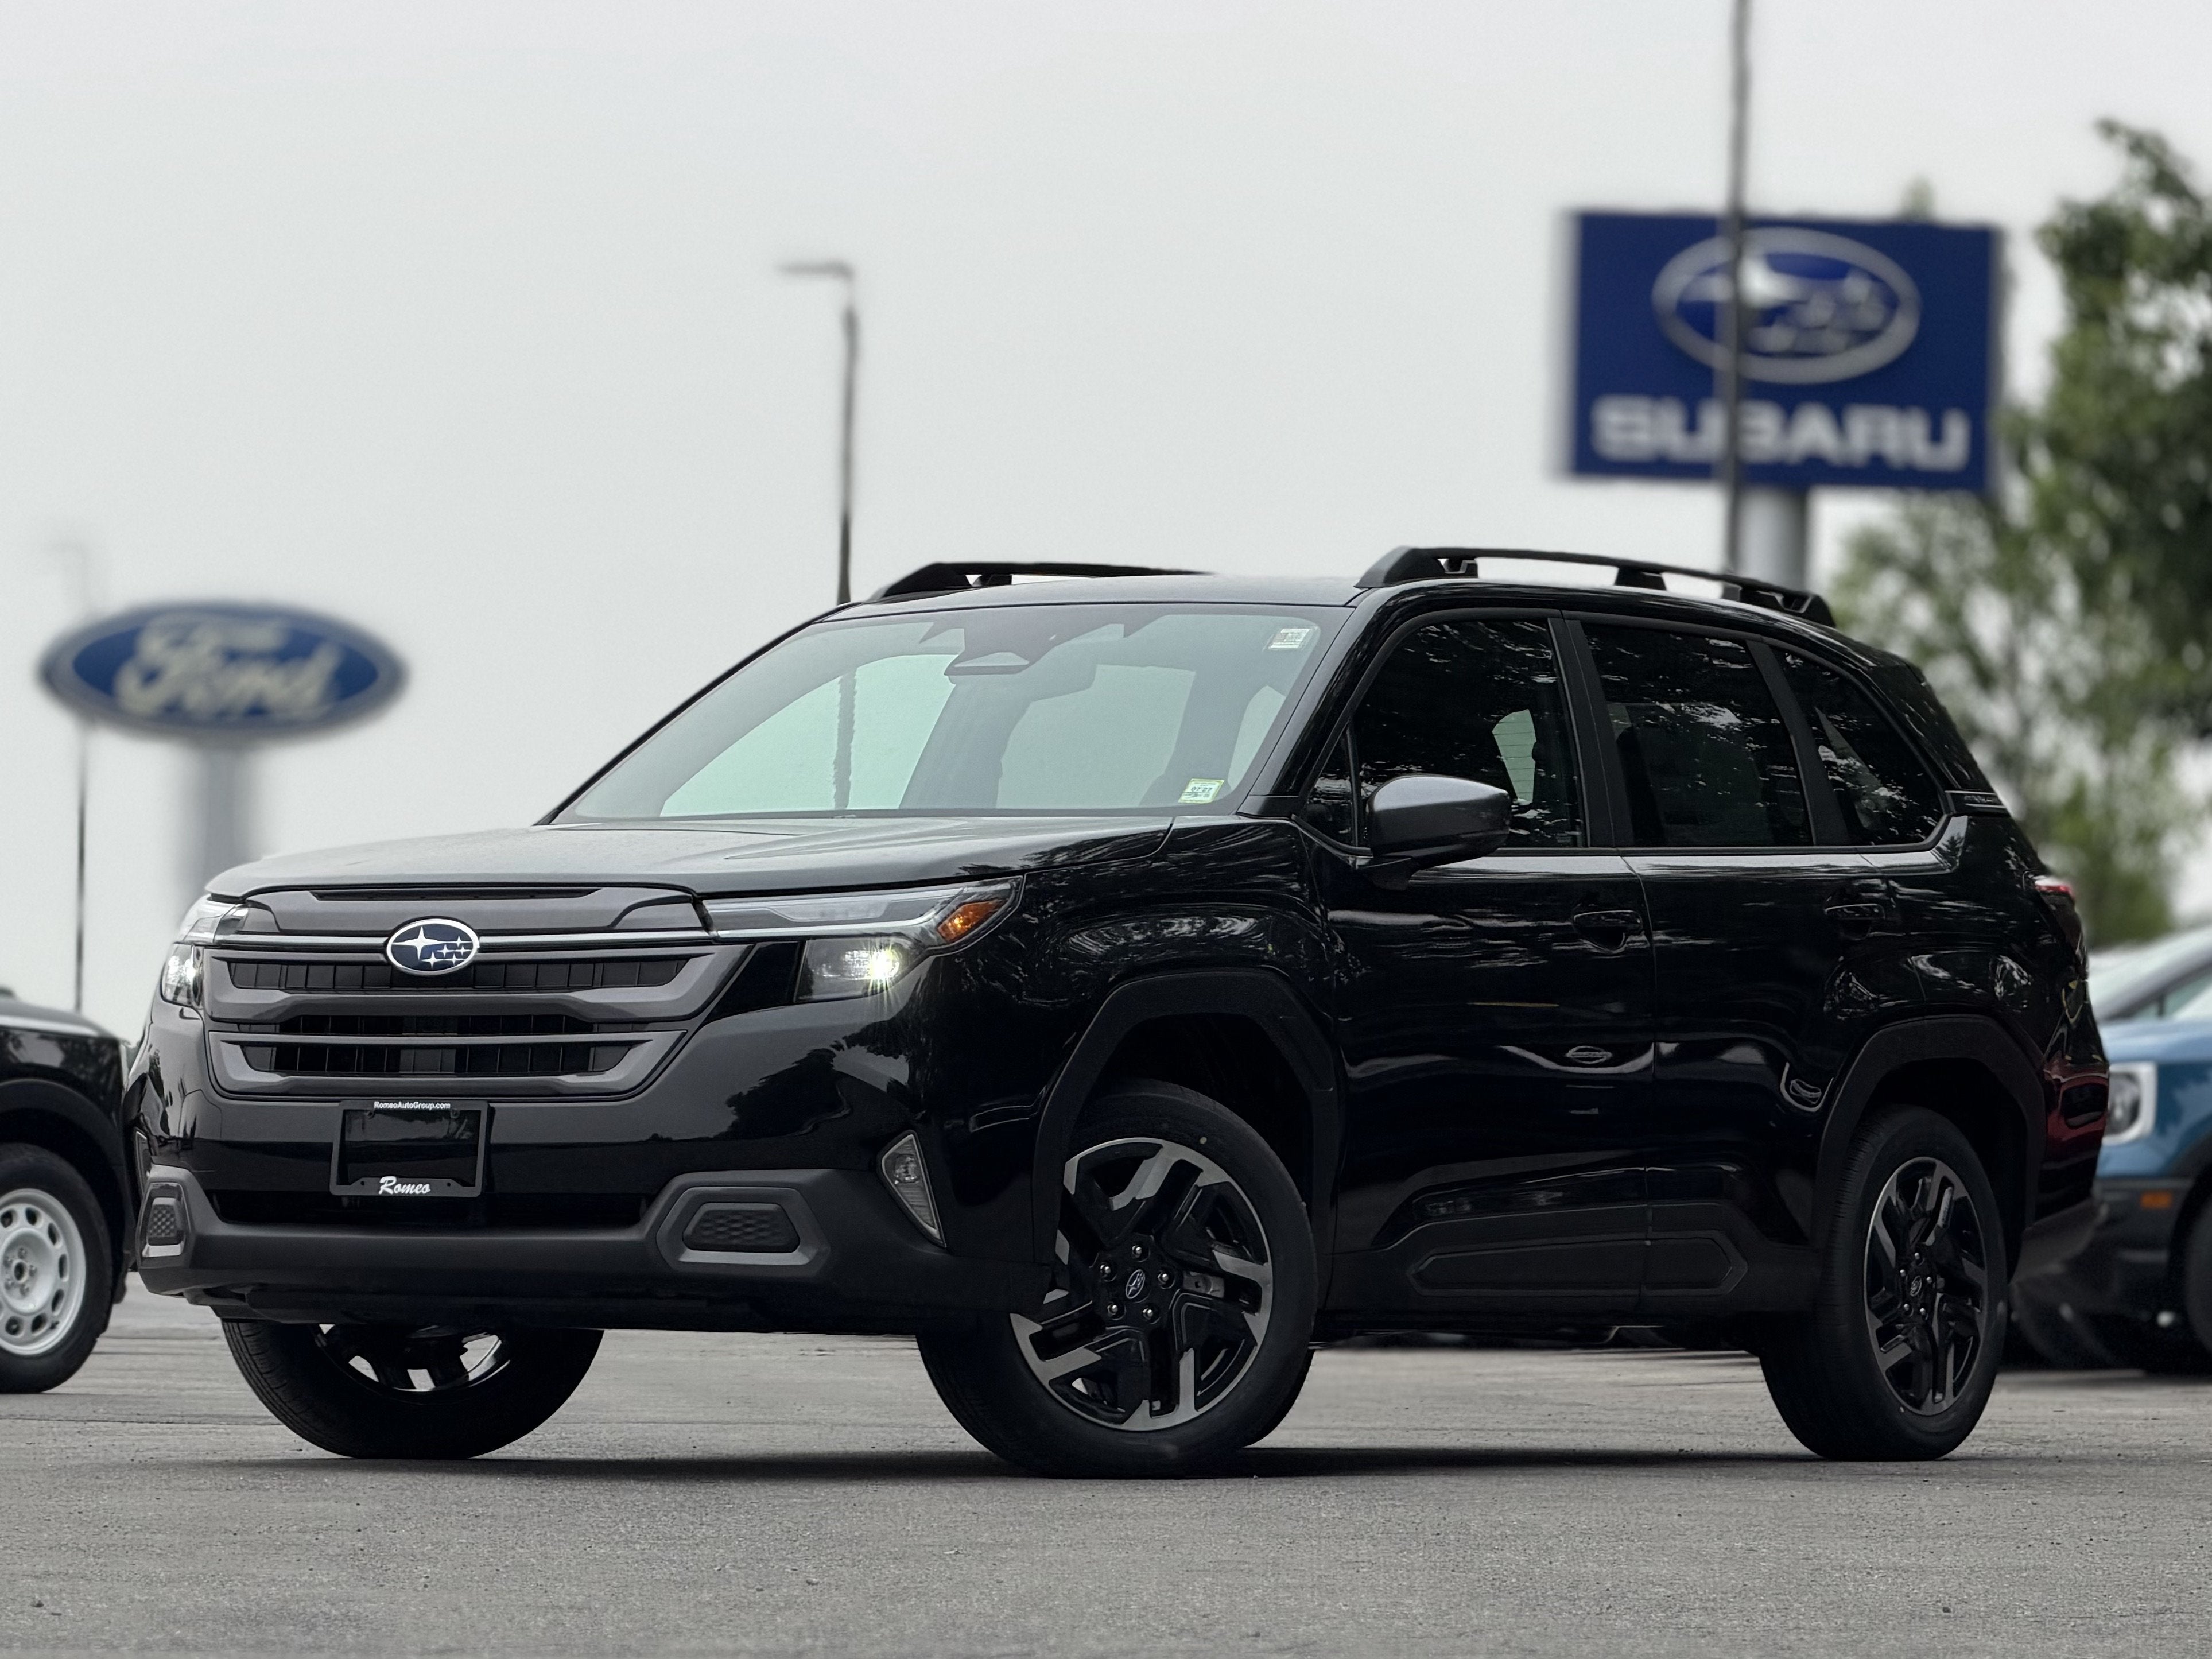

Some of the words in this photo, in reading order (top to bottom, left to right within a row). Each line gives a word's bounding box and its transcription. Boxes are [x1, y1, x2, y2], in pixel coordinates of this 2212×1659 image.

[1593, 396, 1970, 470] SUBARU
[117, 615, 341, 718] Ford
[374, 1101, 451, 1111] RomeoAutoGroup.com
[378, 1176, 431, 1195] Romeo
